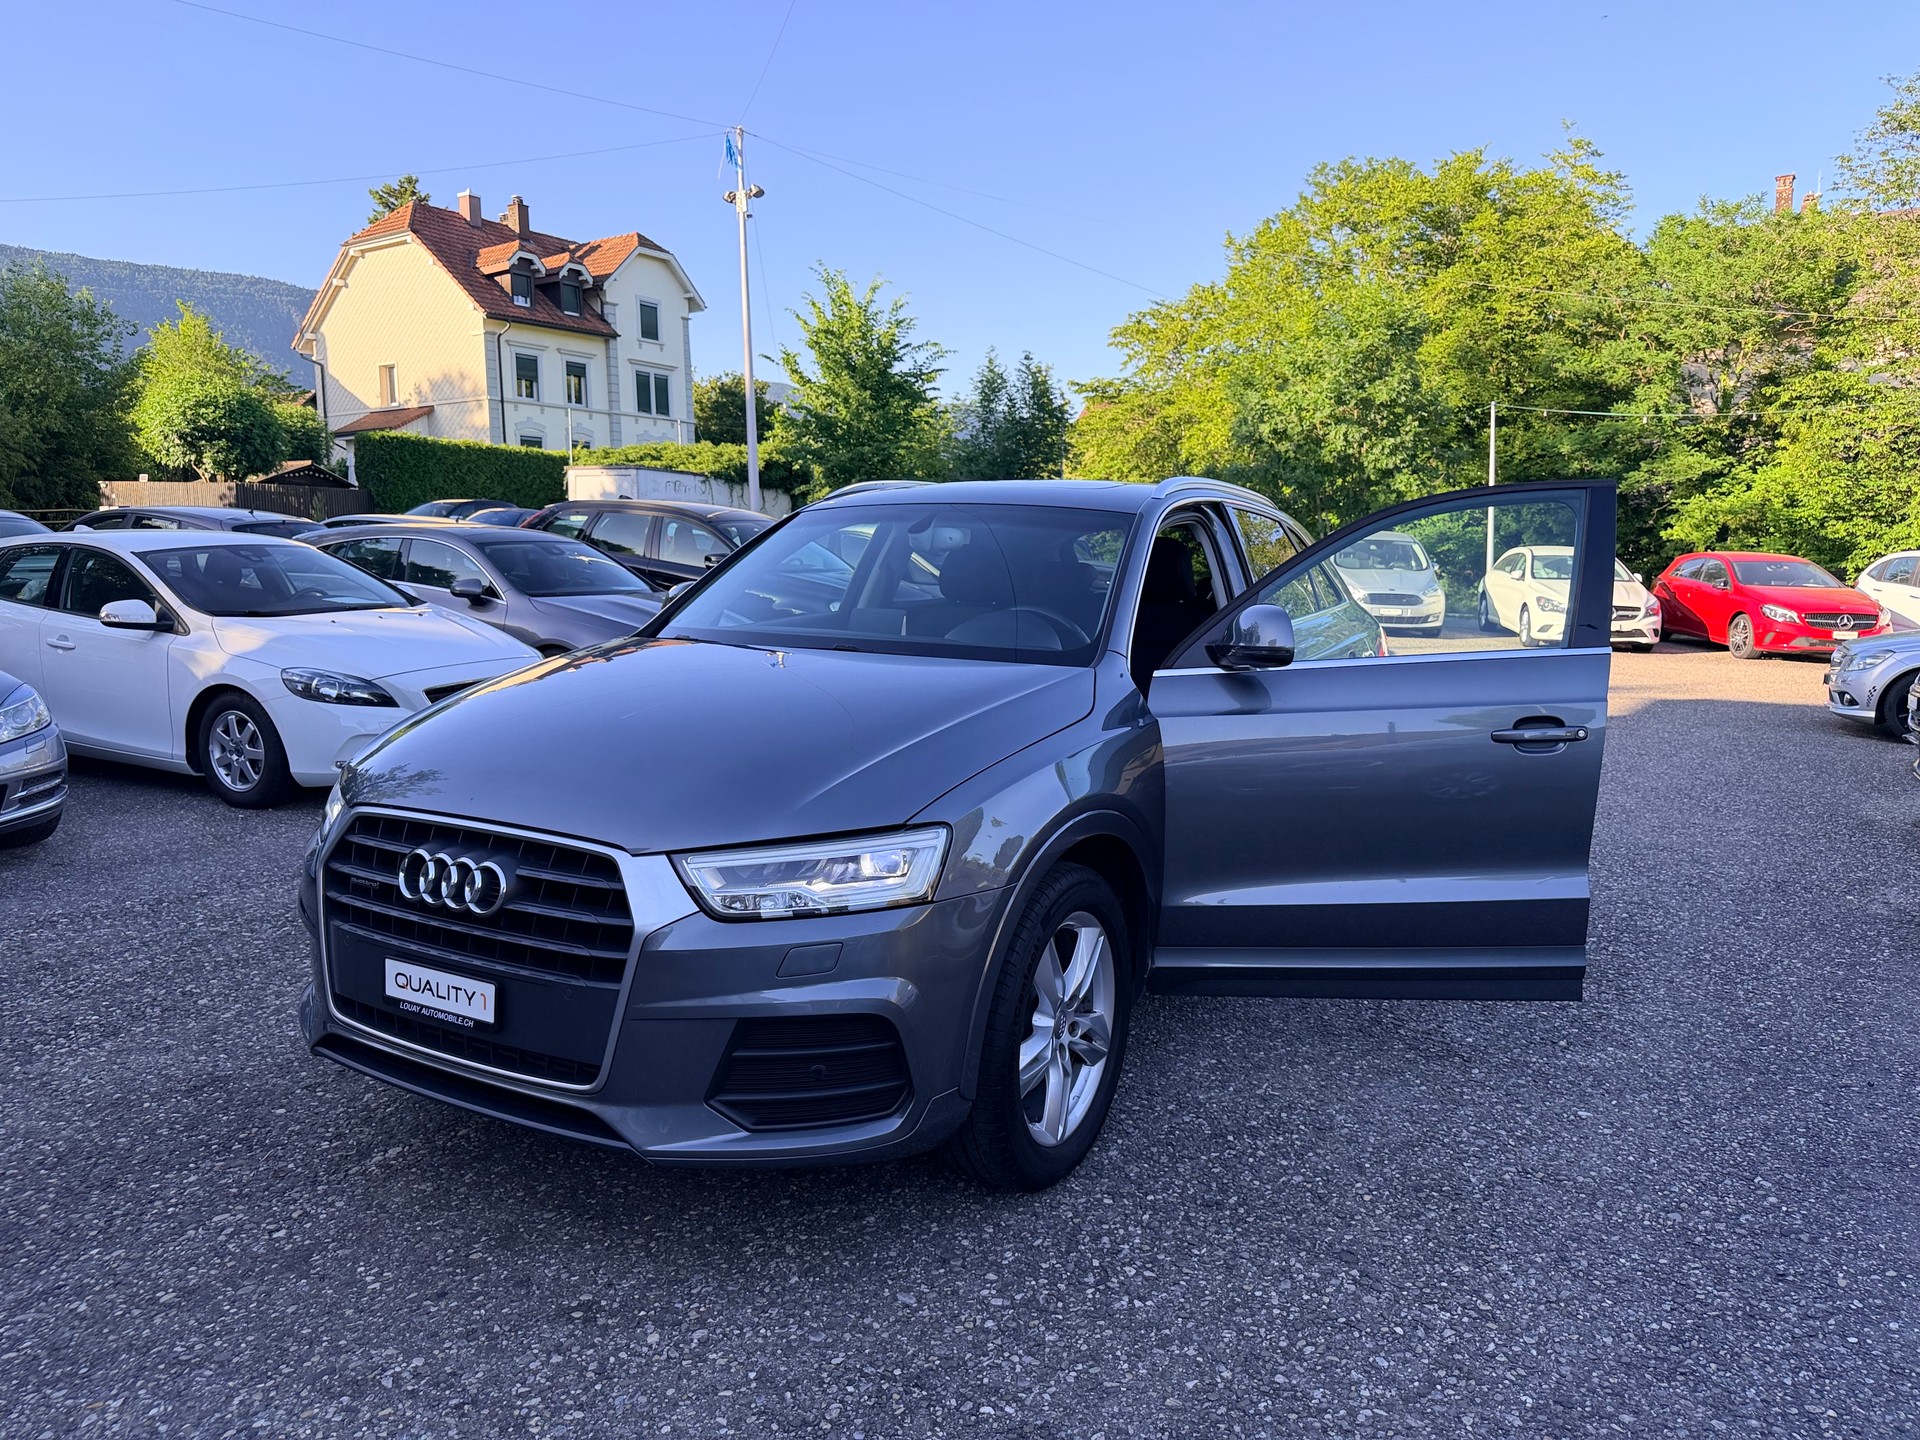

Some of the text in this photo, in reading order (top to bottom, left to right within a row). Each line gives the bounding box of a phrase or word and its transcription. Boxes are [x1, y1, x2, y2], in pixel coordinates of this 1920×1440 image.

[394, 972, 477, 1006] QUALITY
[399, 1001, 474, 1028] LOUAY AUTOMOBILE.CH
